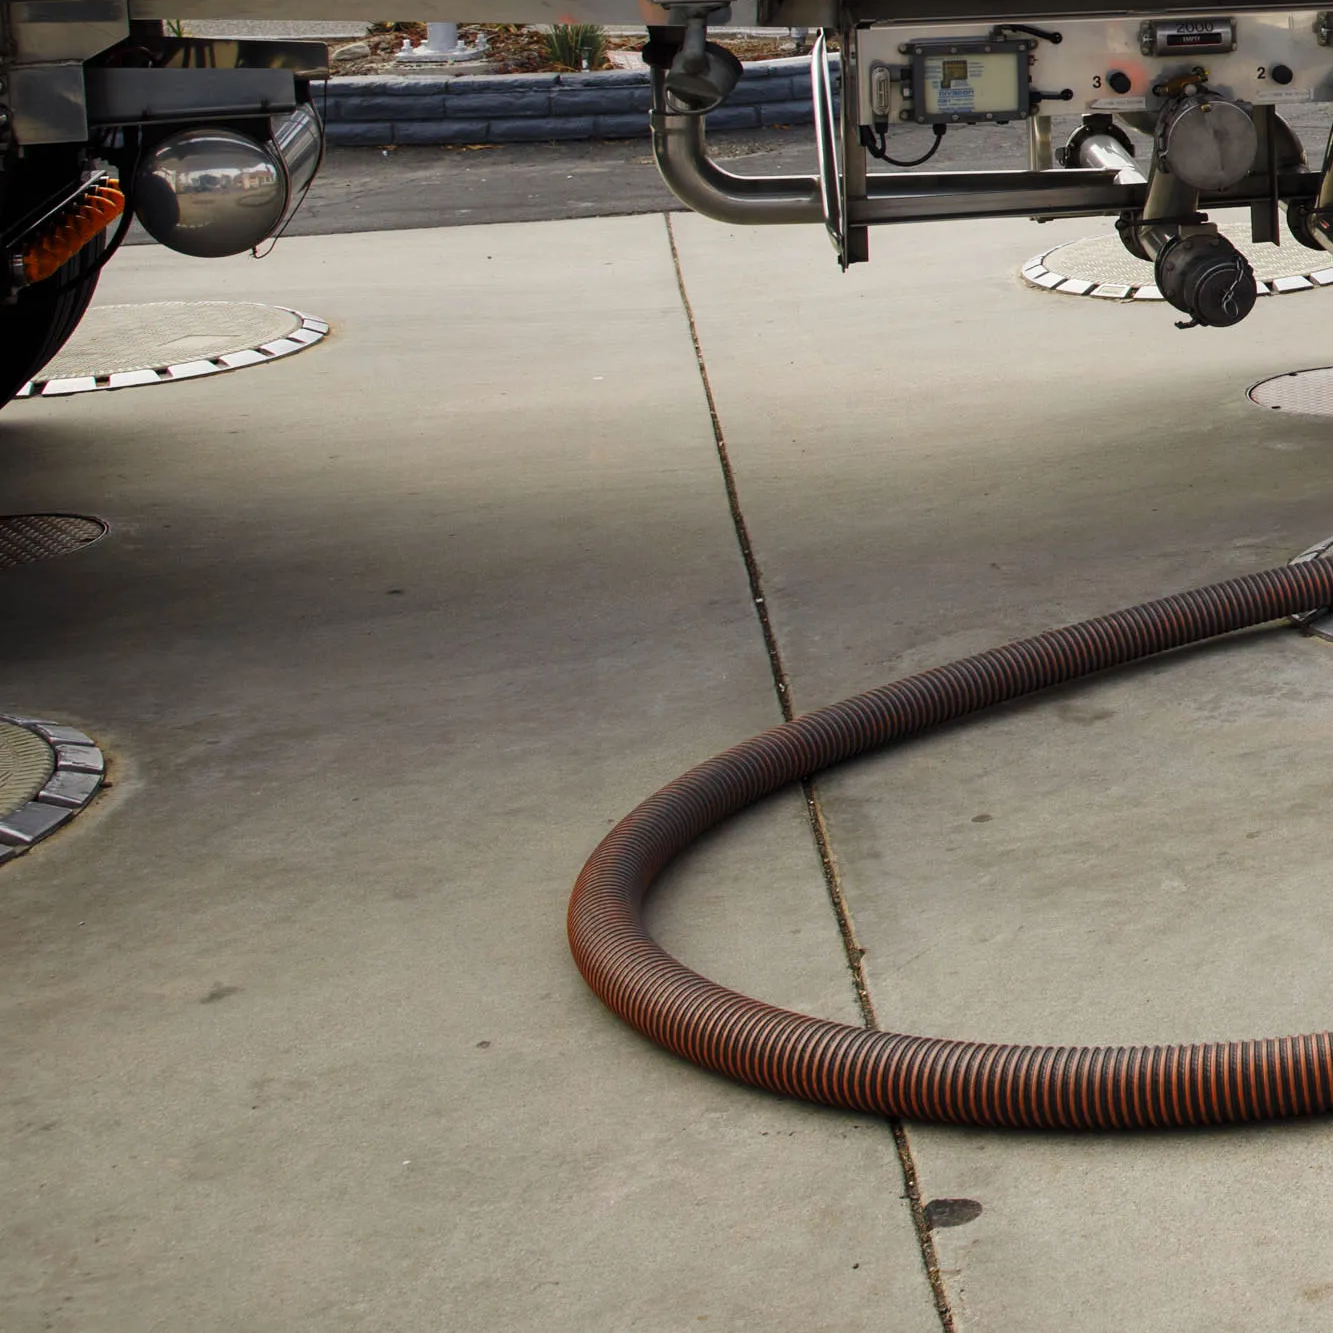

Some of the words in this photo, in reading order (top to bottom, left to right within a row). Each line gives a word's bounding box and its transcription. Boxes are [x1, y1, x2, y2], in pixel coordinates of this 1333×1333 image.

[1177, 22, 1214, 34] 2000
[1256, 66, 1266, 79] 2
[1092, 75, 1102, 89] 3
